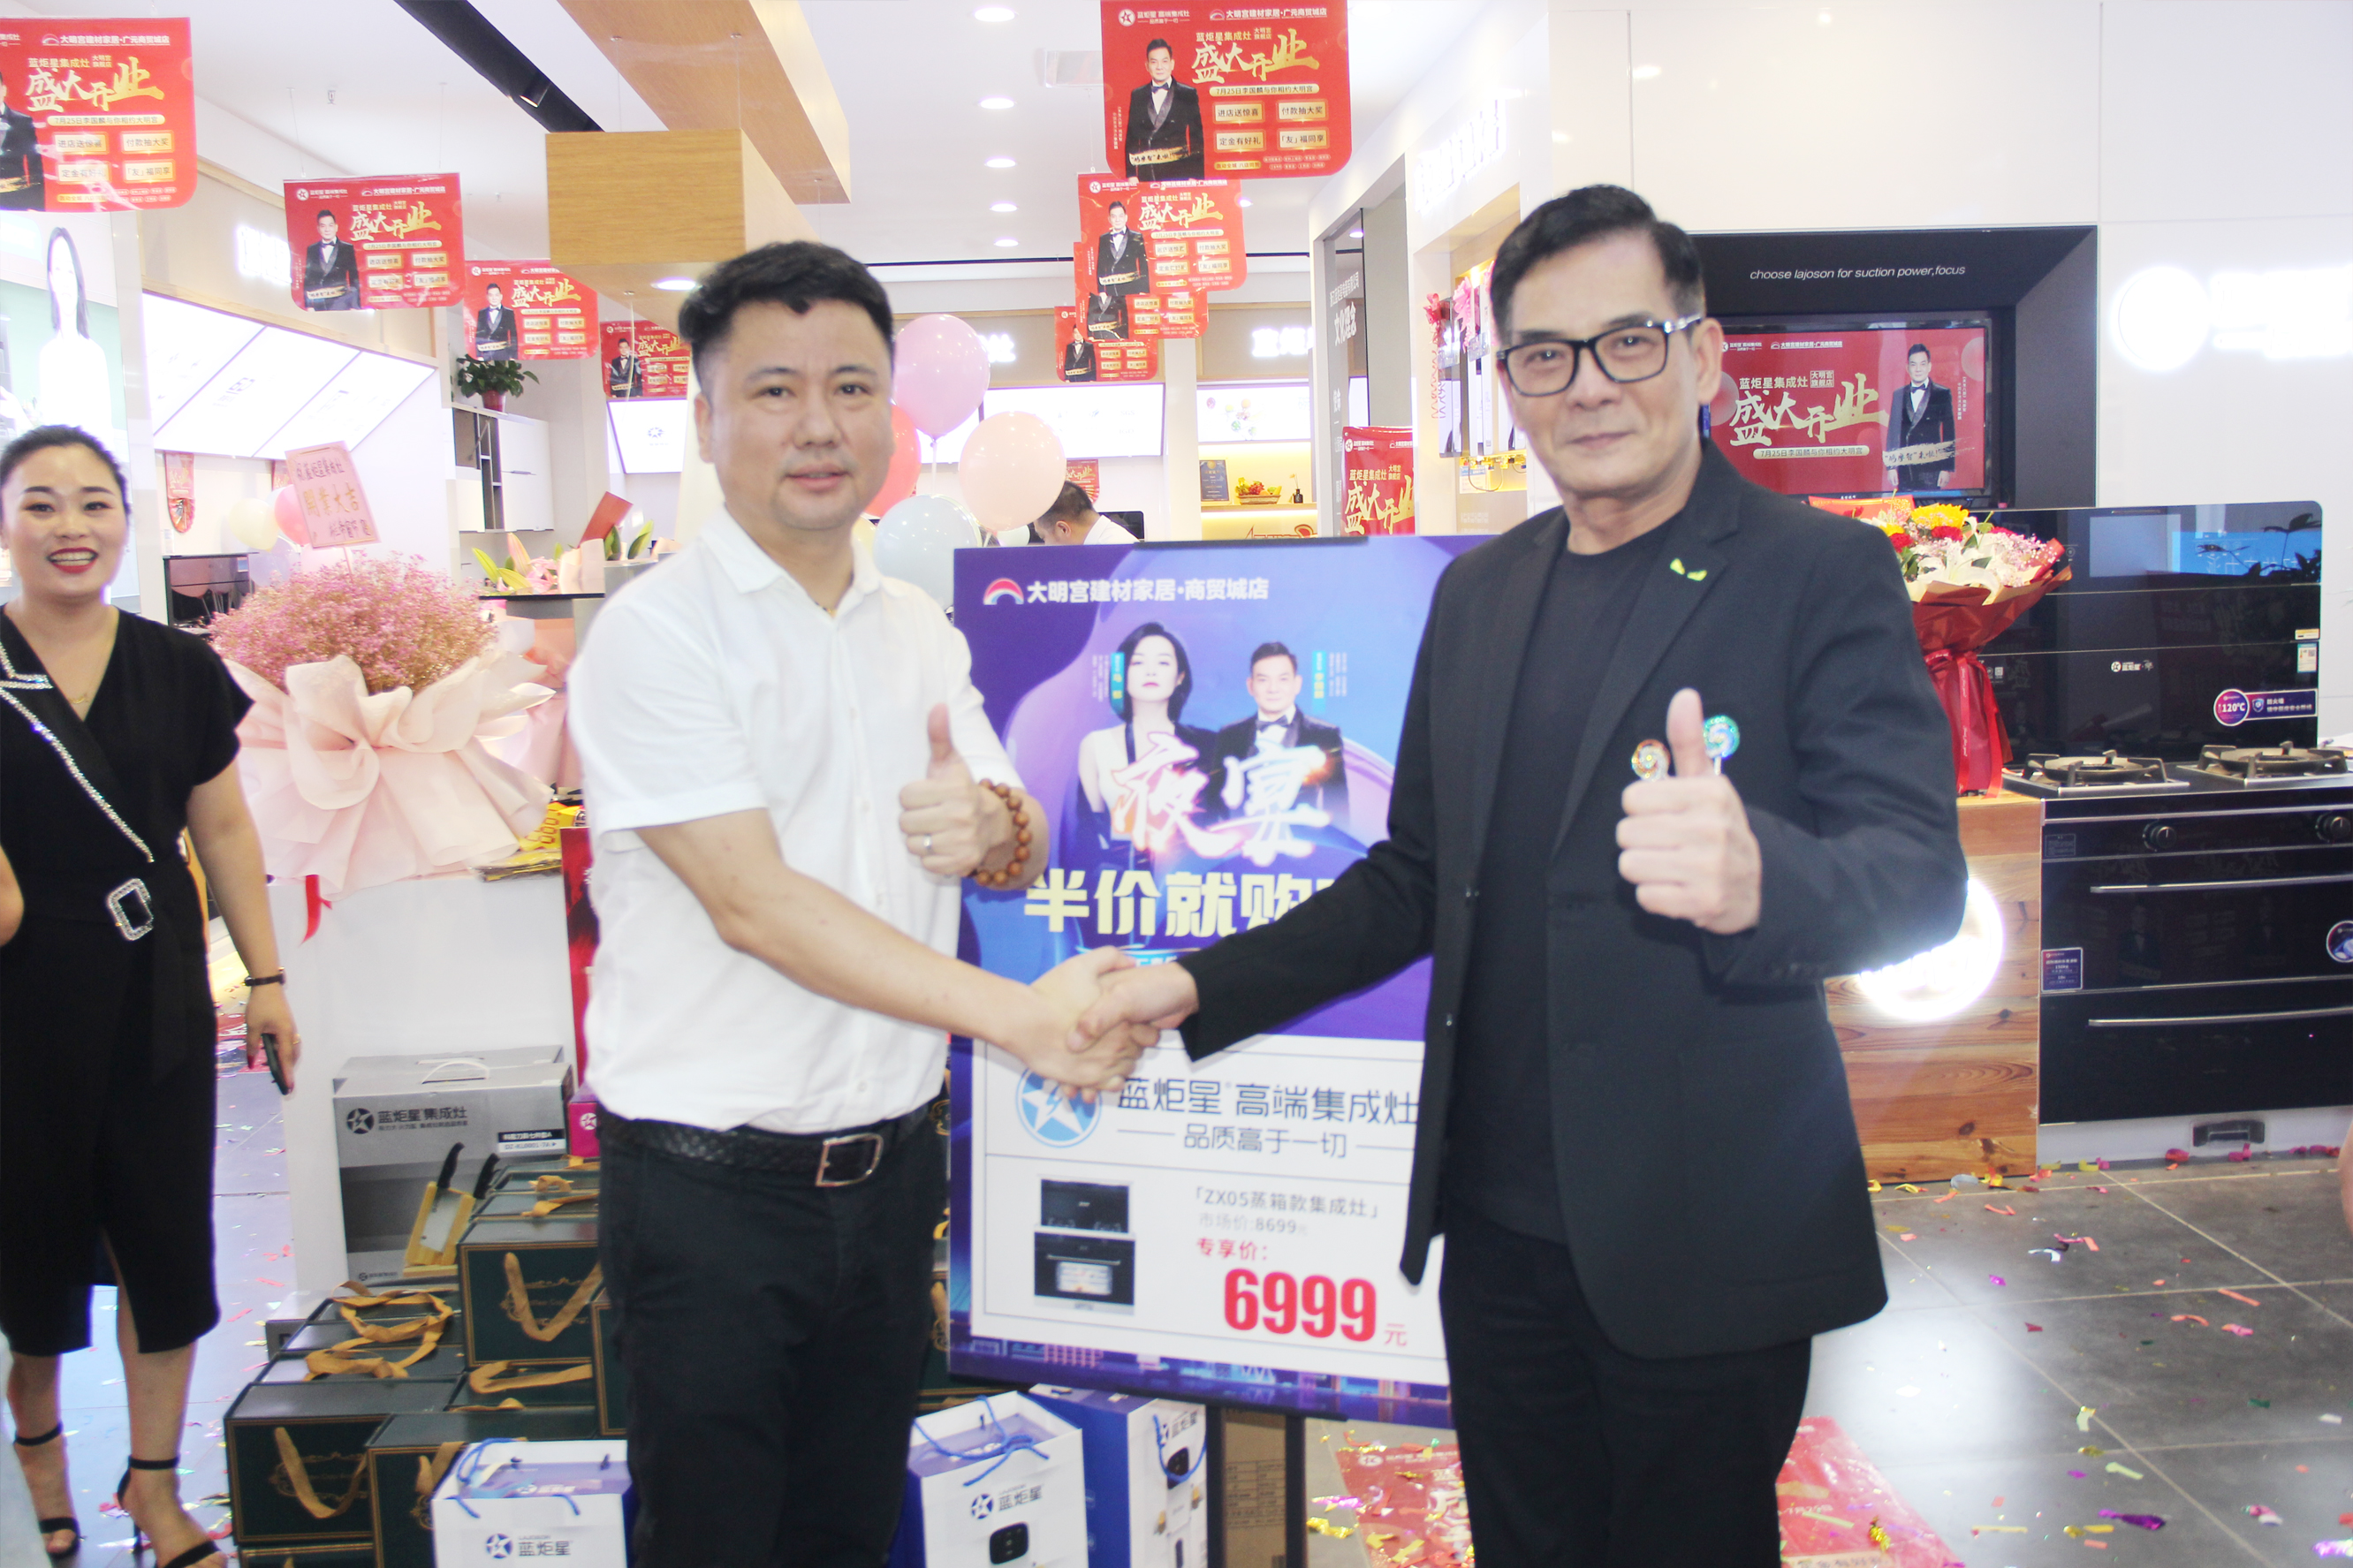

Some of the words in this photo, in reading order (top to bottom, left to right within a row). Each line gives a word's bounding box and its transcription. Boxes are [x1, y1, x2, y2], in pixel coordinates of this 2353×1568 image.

[1195, 31, 1252, 42] 蓝炬星集成灶
[28, 57, 90, 68] 蓝炬星集成灶
[1191, 27, 1320, 84] 盛大开业
[26, 56, 165, 113] 盛大开业
[1216, 85, 1313, 95] 7月25日李国麟与你相约大明宫
[1218, 109, 1259, 117] 进店送惊喜
[1281, 106, 1324, 115] 付款抽大奖
[125, 137, 170, 148] 付款抽大奖
[1219, 137, 1261, 147] 定金有好礼
[1281, 133, 1325, 144] 「友」福同享
[350, 201, 442, 241] 盛大开业
[1139, 192, 1224, 231] 盛大开业
[1750, 269, 1792, 280] choose
[1794, 269, 1834, 282] lajoson
[1837, 268, 1853, 278] for
[1855, 267, 1895, 278] suction
[511, 277, 582, 308] 盛大开业
[1739, 375, 1809, 390] 蓝炬星集成灶
[1729, 372, 1889, 446] 盛大开业
[1760, 446, 1863, 458] 7月25日李国麟与你相约大明宫
[1027, 577, 1270, 604] 大明宫建材家居·商贸城店
[1023, 868, 1336, 938] 半价就购
[1184, 1124, 1347, 1158] 品质高于一切
[1224, 1268, 1377, 1342] 6999
[1384, 1323, 1408, 1346] 元
[998, 1485, 1043, 1511] 蓝炬星
[518, 1541, 572, 1557] 蓝炬星
